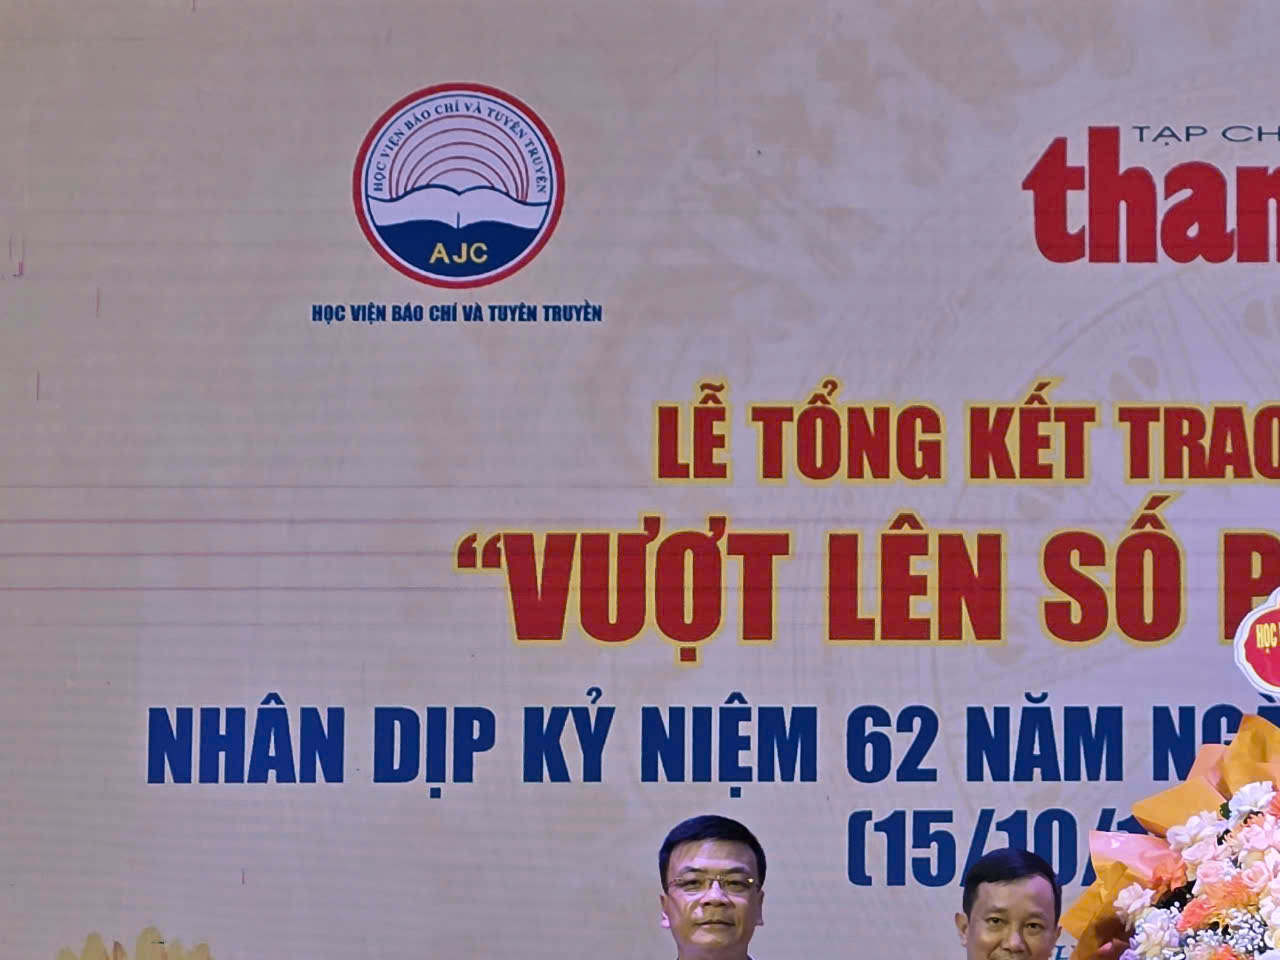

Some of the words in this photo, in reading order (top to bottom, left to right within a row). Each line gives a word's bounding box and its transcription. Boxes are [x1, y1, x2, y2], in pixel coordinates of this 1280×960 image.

[1133, 125, 1208, 147] TẠP
[429, 242, 489, 264] AJC
[311, 304, 346, 325] HỌC
[350, 302, 386, 326] VIỆN
[391, 302, 424, 322] BÁO
[429, 302, 457, 322] CHÍ
[462, 302, 484, 322] VÀ
[487, 302, 538, 322] TUYÊN
[542, 299, 603, 322] TRUYỀN
[655, 381, 729, 481] LỄ
[749, 378, 943, 482] TỔNG
[967, 380, 1097, 481] KẾT
[455, 514, 791, 662] “VƯỢT
[827, 511, 1003, 642] LÊN
[1042, 494, 1183, 643] SỐ
[1256, 623, 1277, 653] HỌC
[147, 692, 345, 784] NHÂN
[372, 706, 496, 799] DỊP
[523, 687, 617, 783] KỶ
[640, 691, 818, 799] NIỆM
[846, 704, 940, 784] 62
[966, 691, 1124, 782] NĂM
